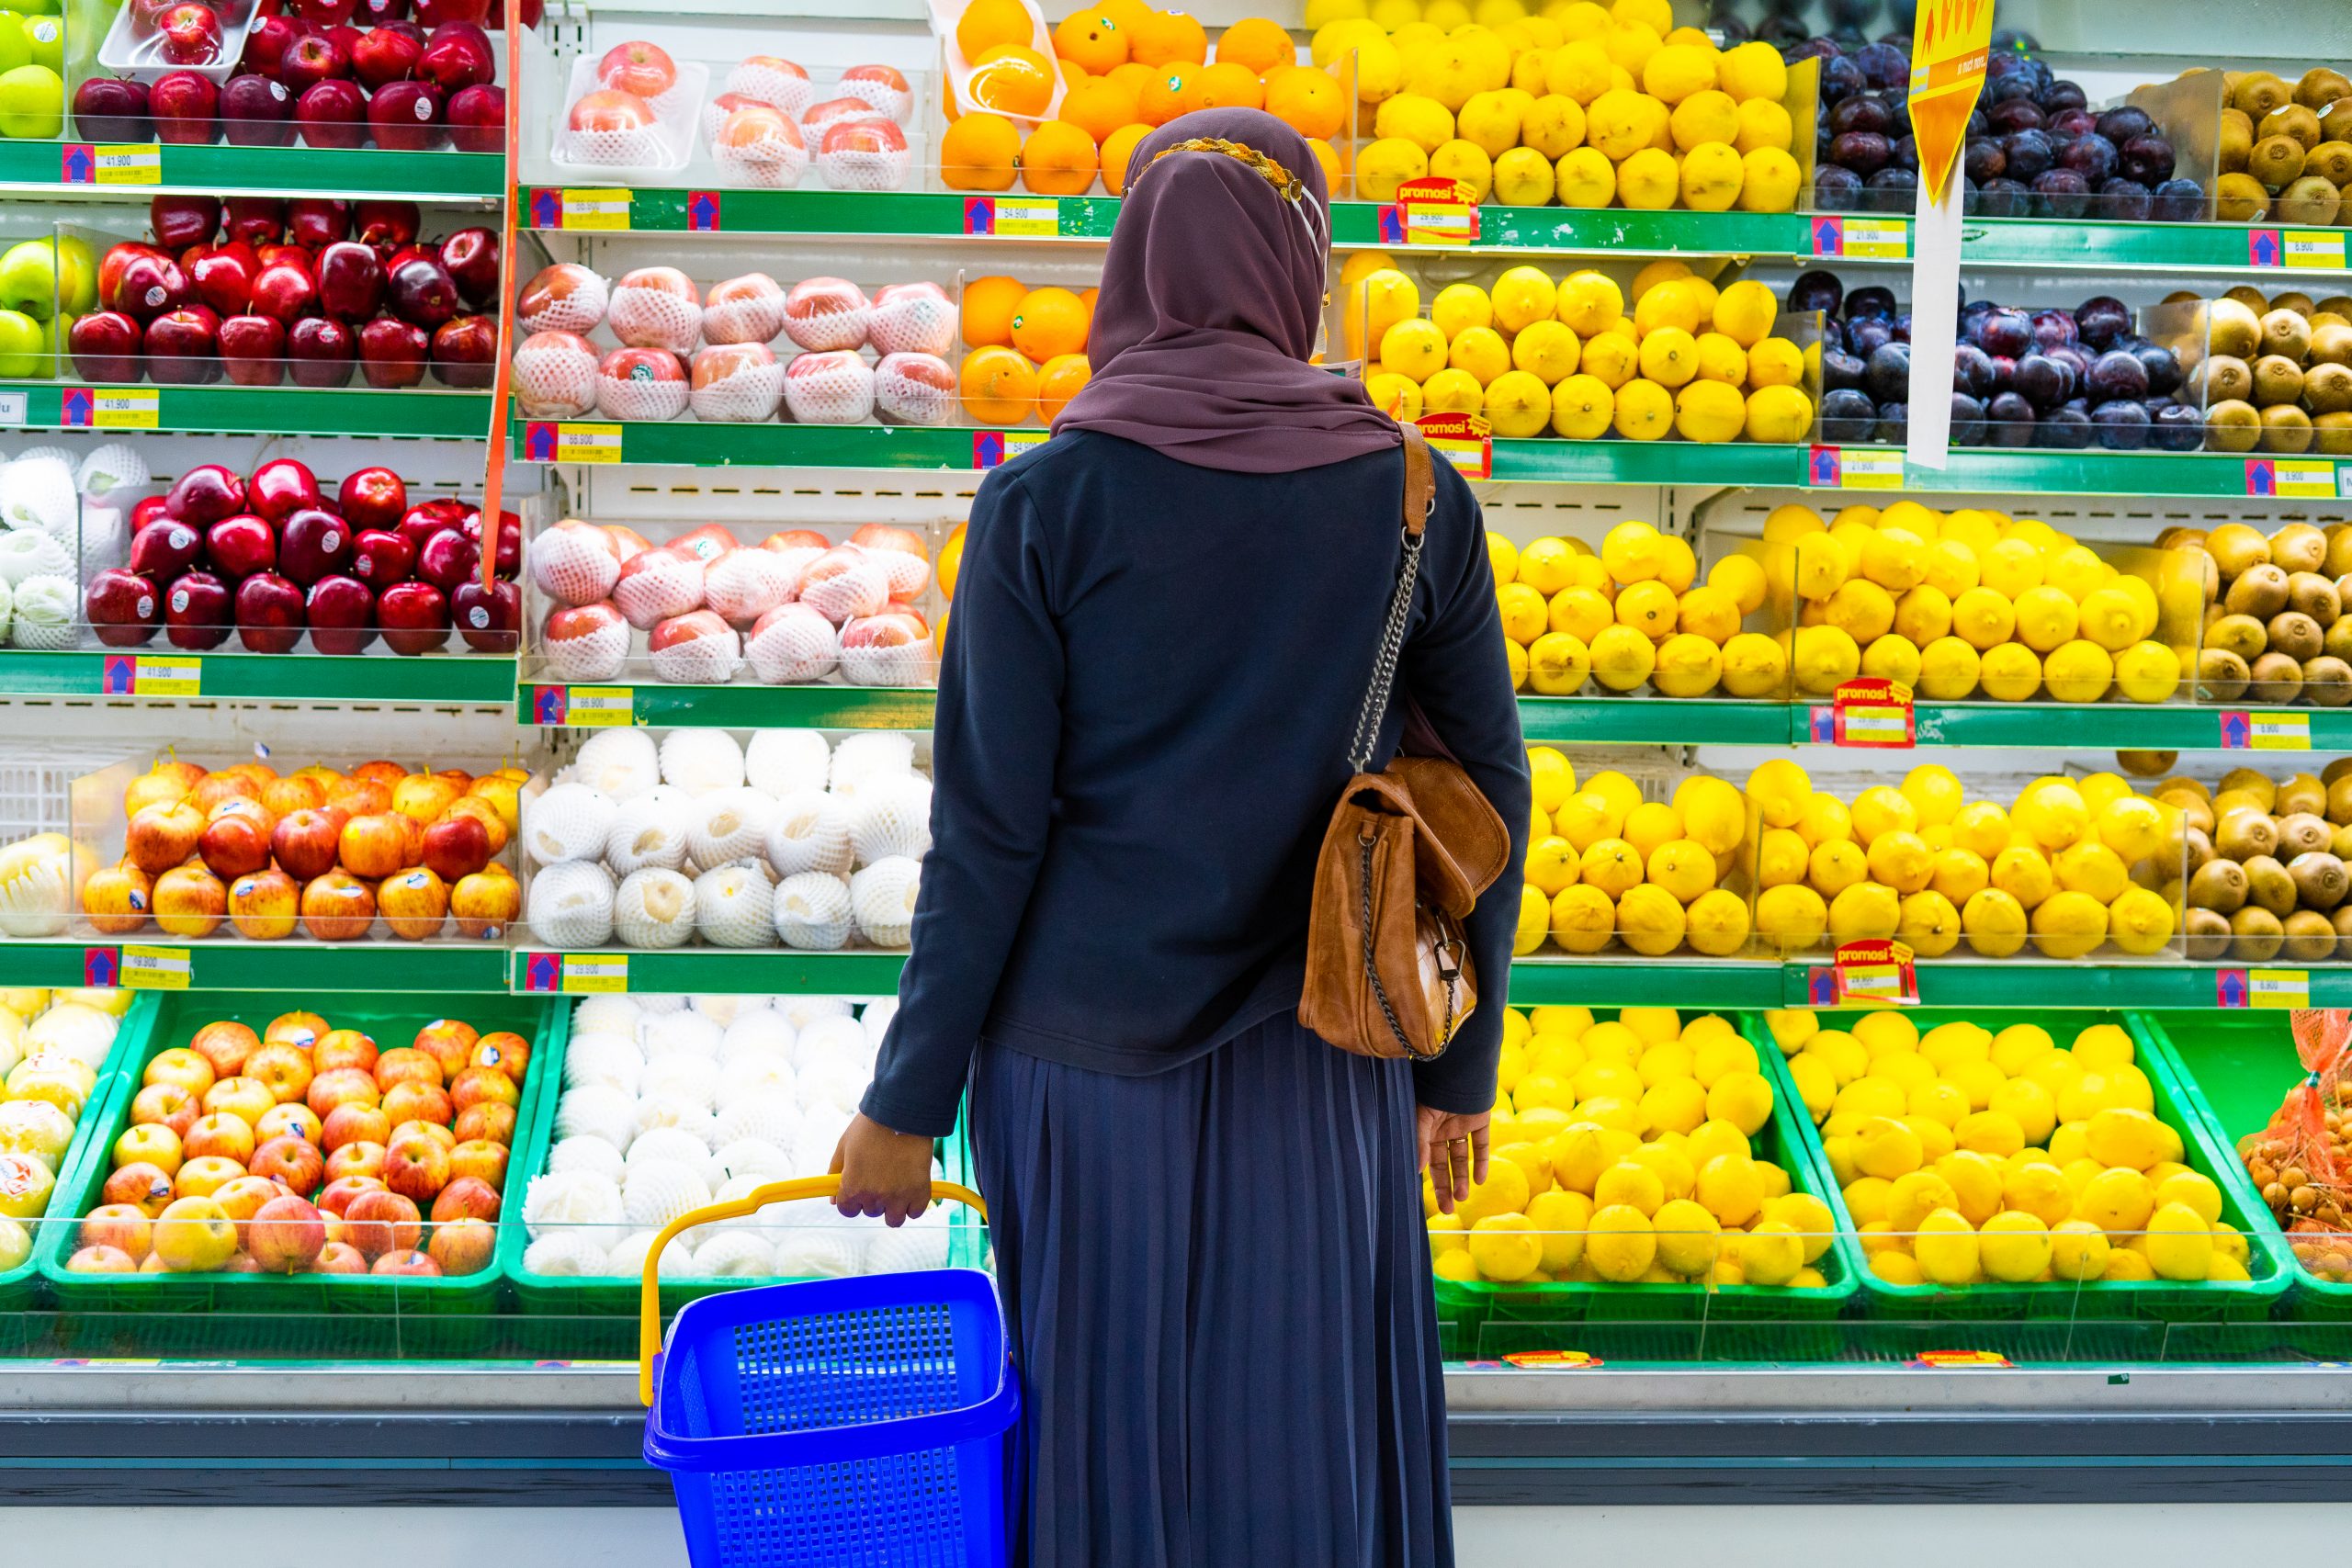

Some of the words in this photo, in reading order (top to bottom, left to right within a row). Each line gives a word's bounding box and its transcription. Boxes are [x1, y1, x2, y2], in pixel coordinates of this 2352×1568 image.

[1962, 55, 1973, 73] much
[106, 154, 131, 166] 41.900
[1399, 186, 1451, 200] promosi
[1004, 208, 1028, 219] 54.900
[2294, 241, 2313, 252] 8.900
[105, 399, 130, 410] 41.900
[569, 434, 593, 445] 66.900
[146, 666, 172, 678] 41.900
[1838, 686, 1887, 701] promosi
[580, 697, 605, 708] 66.900
[1838, 948, 1887, 964] promosi
